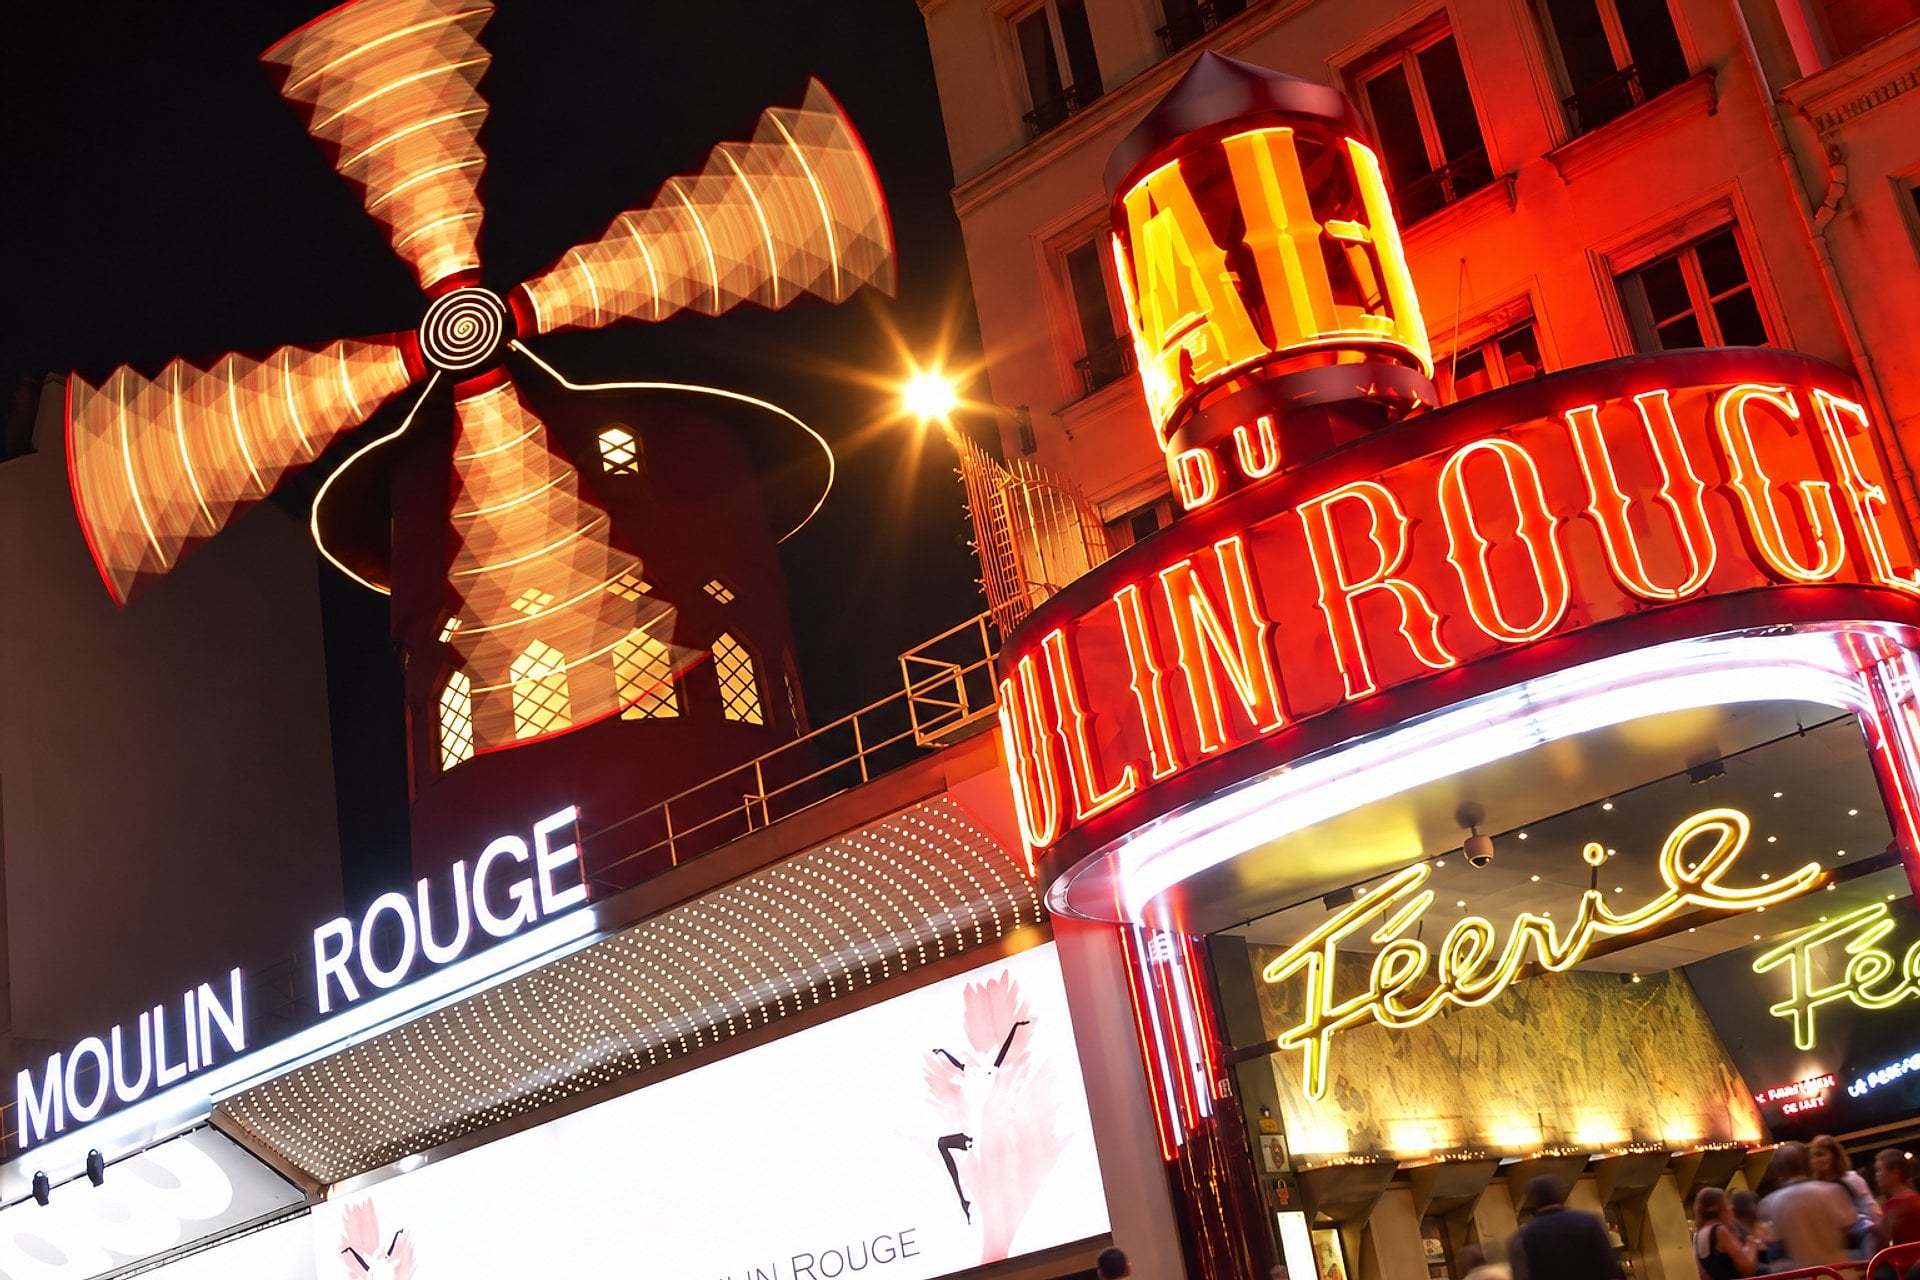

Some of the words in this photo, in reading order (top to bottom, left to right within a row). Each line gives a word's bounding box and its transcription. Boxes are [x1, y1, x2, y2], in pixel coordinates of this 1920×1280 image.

[1174, 416, 1281, 511] DU
[999, 537, 1285, 877] ULIN
[1297, 383, 1920, 700] ROUGE
[16, 967, 249, 1148] MOULIN
[313, 805, 590, 1014] ROUGE
[1263, 808, 1821, 1101] Féerie
[792, 1228, 920, 1280] ROUGE
